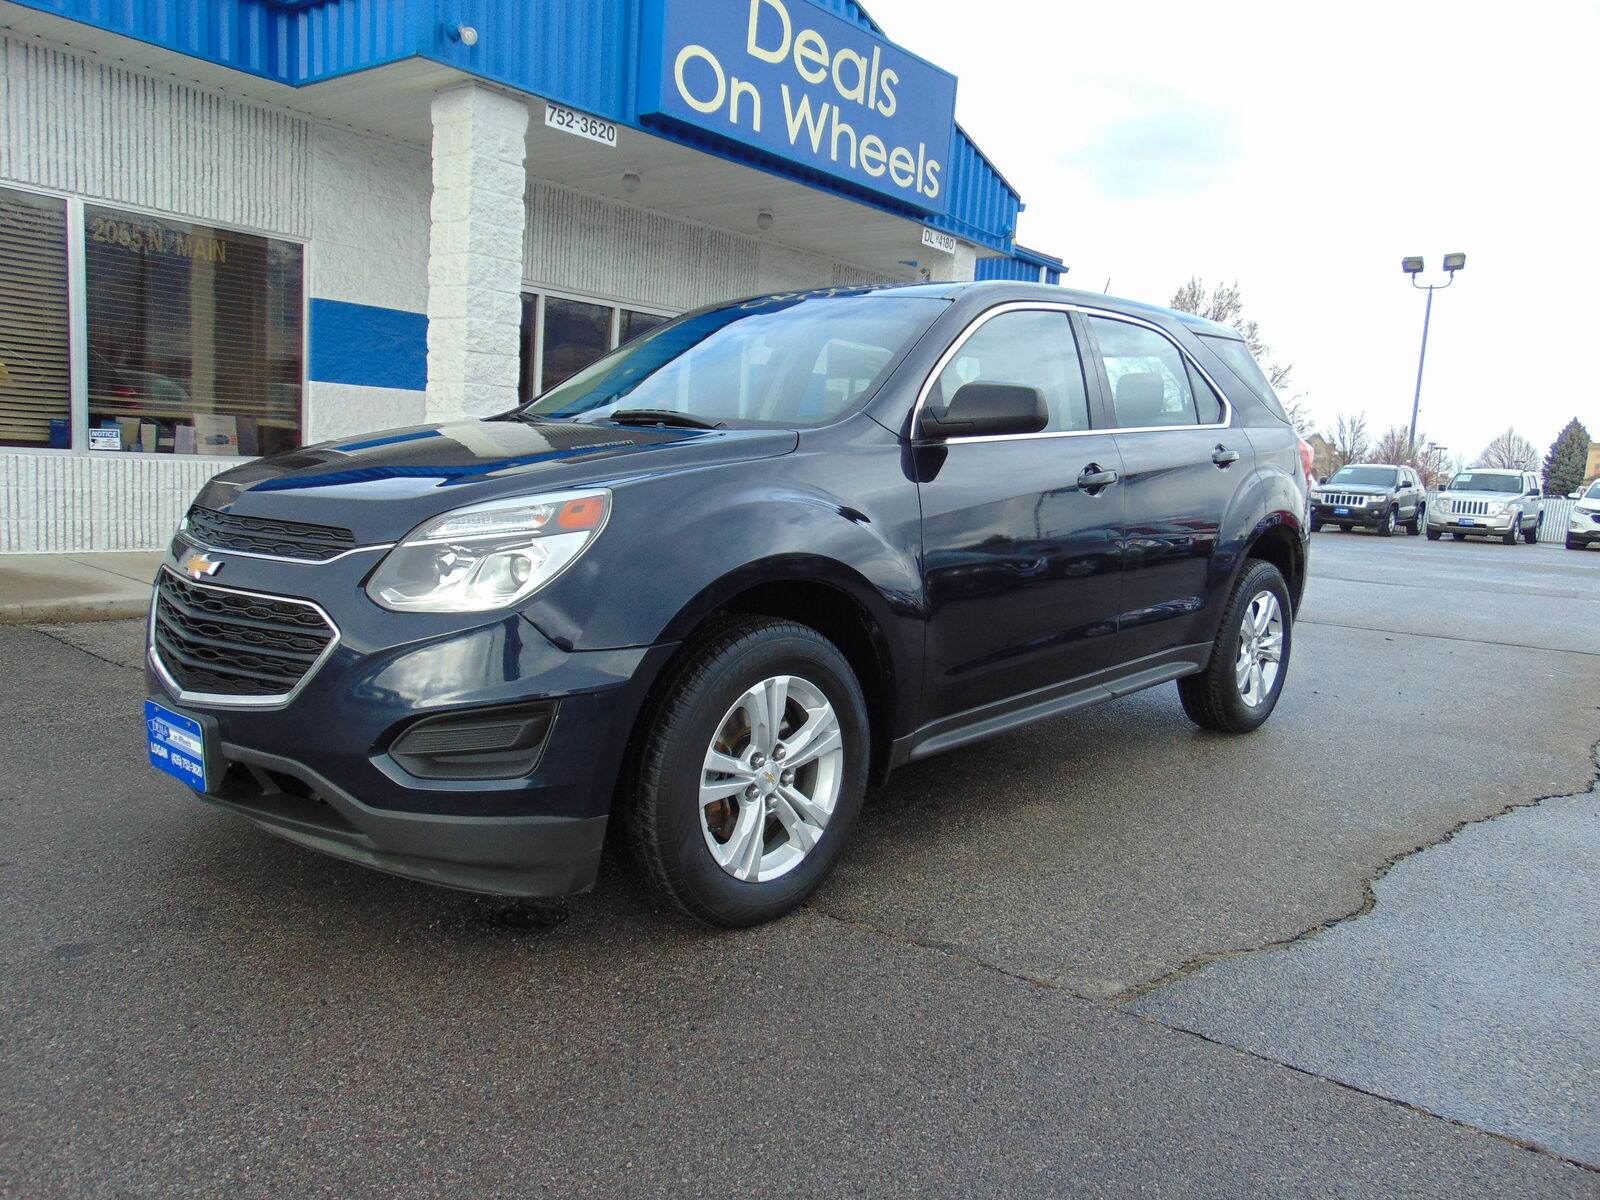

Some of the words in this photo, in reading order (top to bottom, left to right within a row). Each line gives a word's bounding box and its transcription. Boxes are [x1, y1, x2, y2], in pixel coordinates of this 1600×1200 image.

[747, 0, 899, 117] Deals
[548, 104, 615, 142] 752-3620
[674, 45, 761, 132] On
[781, 84, 941, 198] Wheels
[176, 233, 226, 263] MAIN
[924, 230, 935, 244] DL
[91, 430, 118, 438] NOTICE
[151, 741, 168, 759] LOGAN
[181, 757, 203, 778] 752-3620
